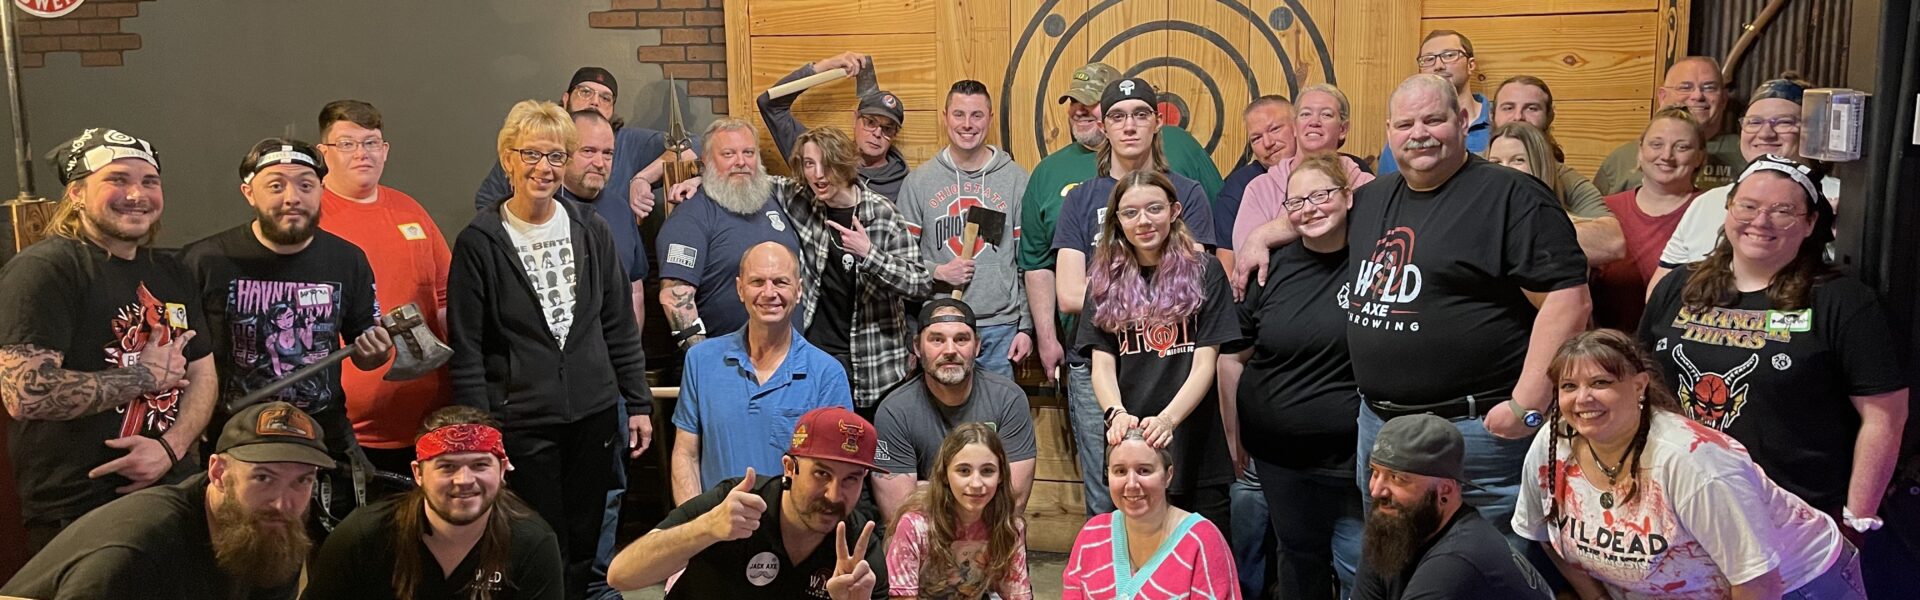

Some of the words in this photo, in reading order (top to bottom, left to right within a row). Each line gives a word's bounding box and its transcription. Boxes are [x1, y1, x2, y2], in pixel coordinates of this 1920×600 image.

[928, 184, 959, 209] OHIO
[964, 182, 1008, 212] STATE
[1347, 311, 1420, 332] HROWING
[1361, 301, 1390, 317] AXE
[1597, 527, 1668, 556] DEAD
